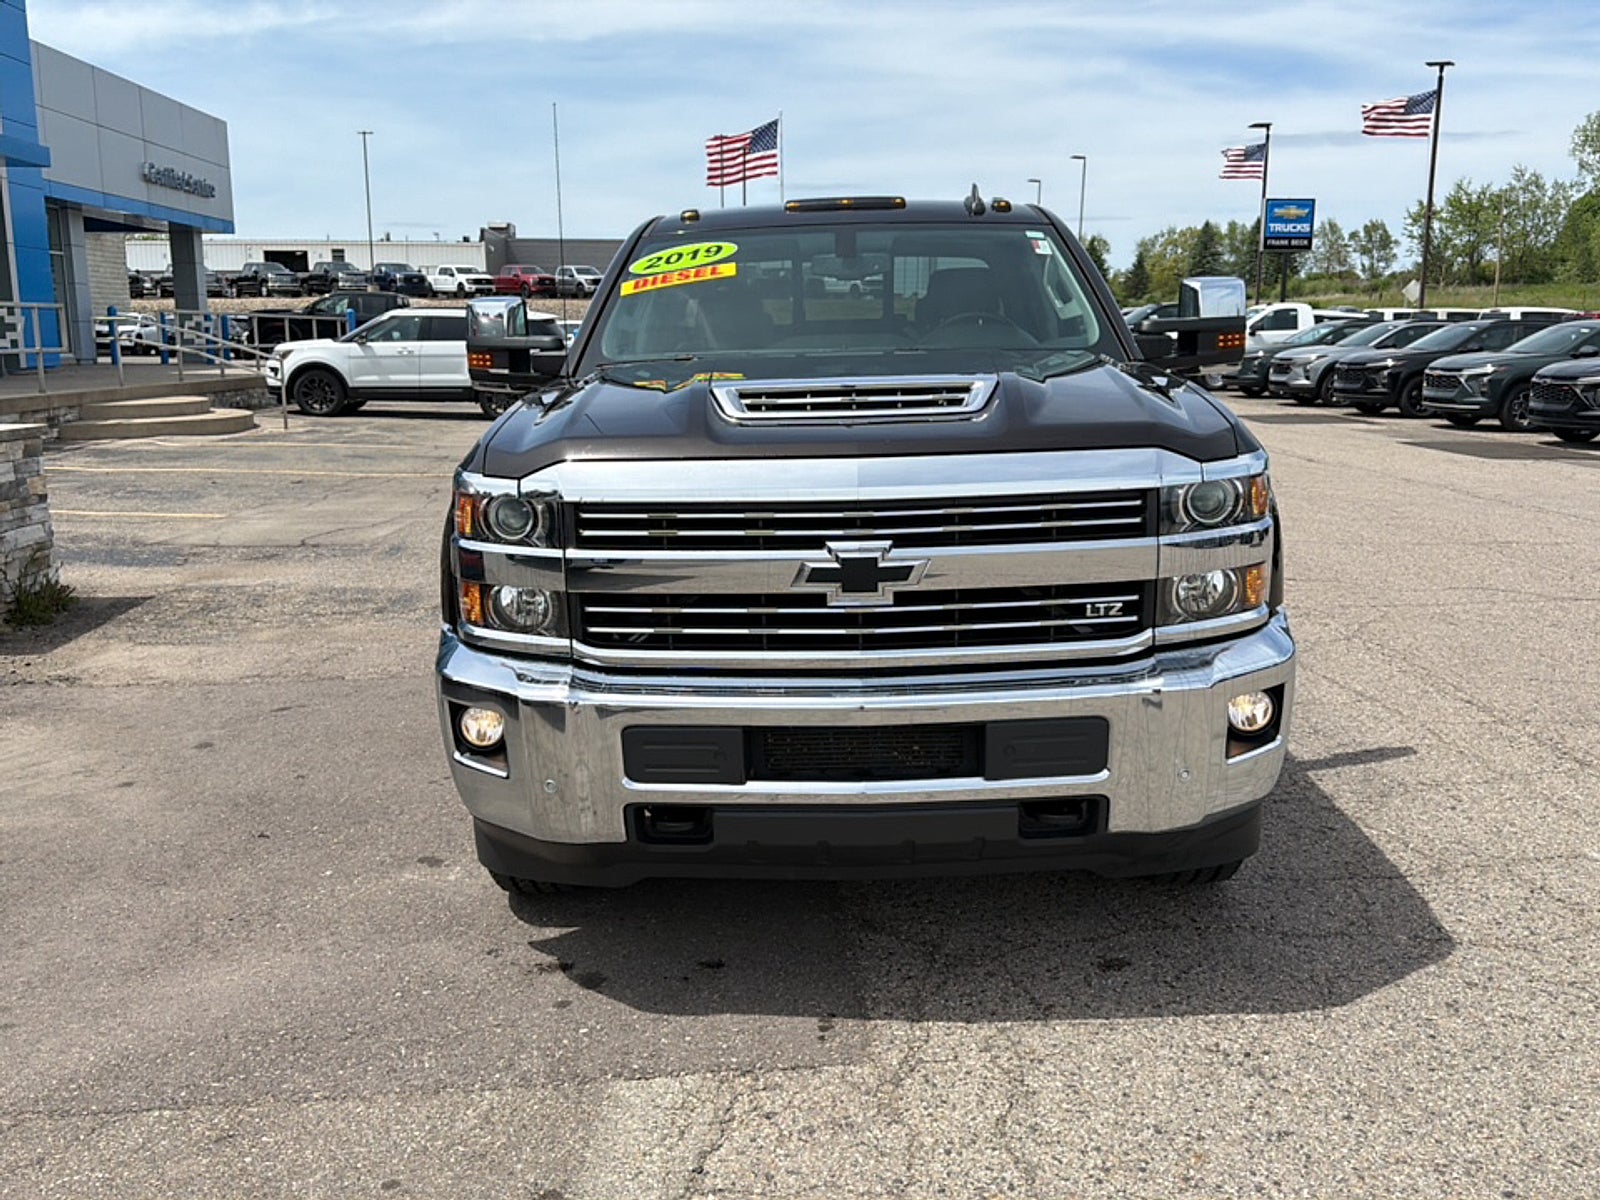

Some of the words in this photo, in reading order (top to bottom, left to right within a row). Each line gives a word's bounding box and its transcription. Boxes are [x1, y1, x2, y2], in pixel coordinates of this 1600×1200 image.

[1268, 223, 1311, 233] TRUCKS
[643, 244, 724, 271] 2019
[633, 266, 724, 291] DIESEL
[1085, 602, 1124, 617] LTZ
